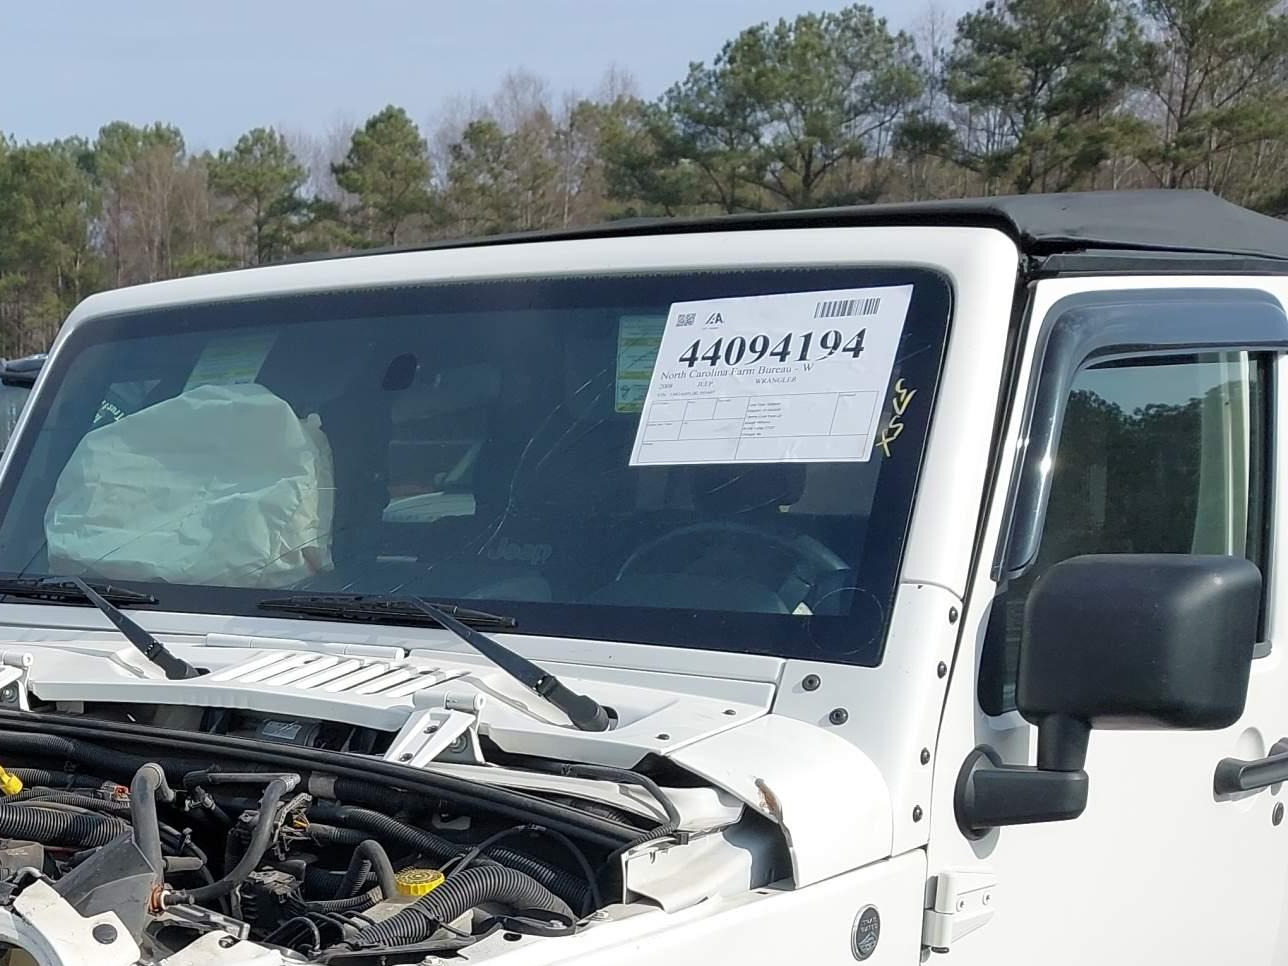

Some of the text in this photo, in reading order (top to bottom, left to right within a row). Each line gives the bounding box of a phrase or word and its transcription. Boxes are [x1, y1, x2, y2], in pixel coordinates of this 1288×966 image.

[678, 327, 867, 368] 44094194
[660, 369, 687, 380] North
[688, 368, 727, 379] Carolina
[730, 367, 755, 377] Farm
[758, 365, 792, 375] Bureau
[802, 362, 814, 372] W
[755, 375, 798, 384] WRANGLER
